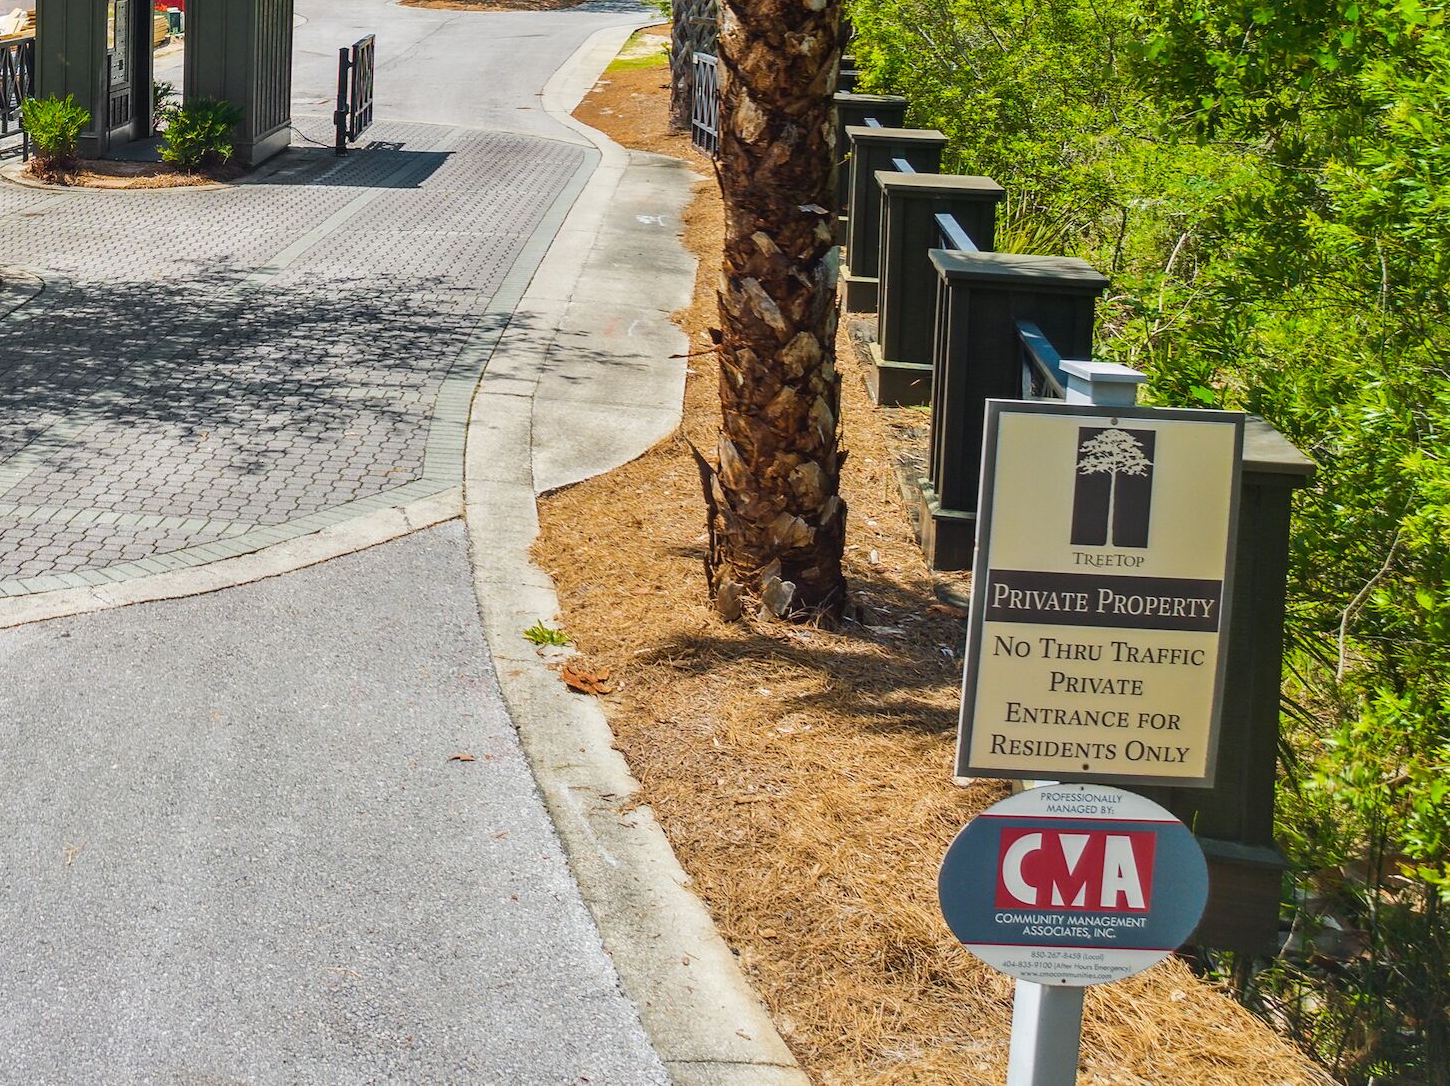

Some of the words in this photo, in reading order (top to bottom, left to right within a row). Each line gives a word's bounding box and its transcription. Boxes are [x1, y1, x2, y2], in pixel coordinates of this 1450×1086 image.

[992, 583, 1089, 612] PRIVATE
[1096, 588, 1215, 618] PROPERTY
[993, 635, 1031, 658] NO
[1039, 638, 1102, 661] THRU
[1111, 641, 1205, 666] TRAFFIC
[1048, 671, 1143, 696] PRIVATE
[1004, 702, 1129, 728] ENTRANCE
[1137, 713, 1181, 730] FOR
[990, 734, 1116, 759] RESIDENTS
[1125, 740, 1190, 763] ONLY
[1040, 792, 1123, 804] PROFESSIONALLY
[1046, 804, 1098, 814] MANAGED
[1100, 805, 1115, 815] BY:
[1001, 832, 1146, 909] CMA
[995, 912, 1065, 926] COMMUNITY
[1067, 915, 1147, 928] MANAGEMENT
[1022, 925, 1091, 939] ASSOCIATES,
[1094, 928, 1116, 939] INC.
